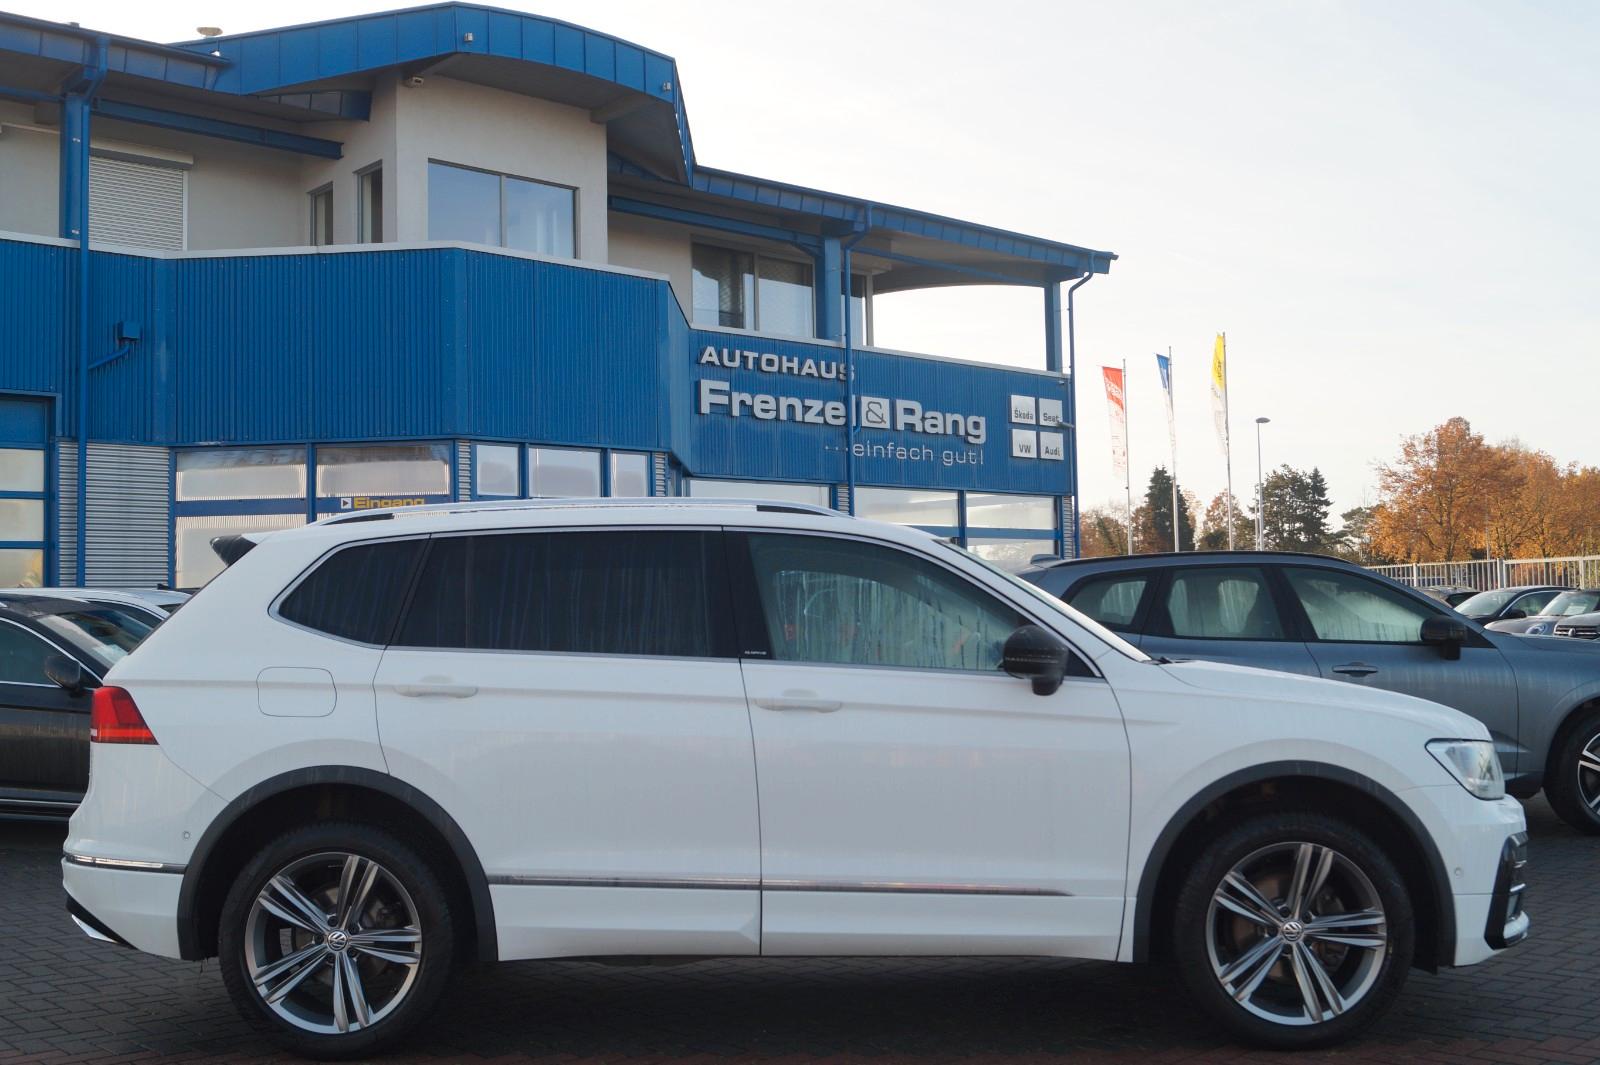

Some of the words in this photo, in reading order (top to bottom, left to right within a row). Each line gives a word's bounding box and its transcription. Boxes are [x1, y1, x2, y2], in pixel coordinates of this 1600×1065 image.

[700, 345, 855, 382] AUTOHAUS
[865, 400, 887, 425] &
[895, 399, 986, 445] Rang
[1043, 412, 1060, 422] Seat
[1019, 443, 1031, 454] VW
[1044, 446, 1061, 457] Audi
